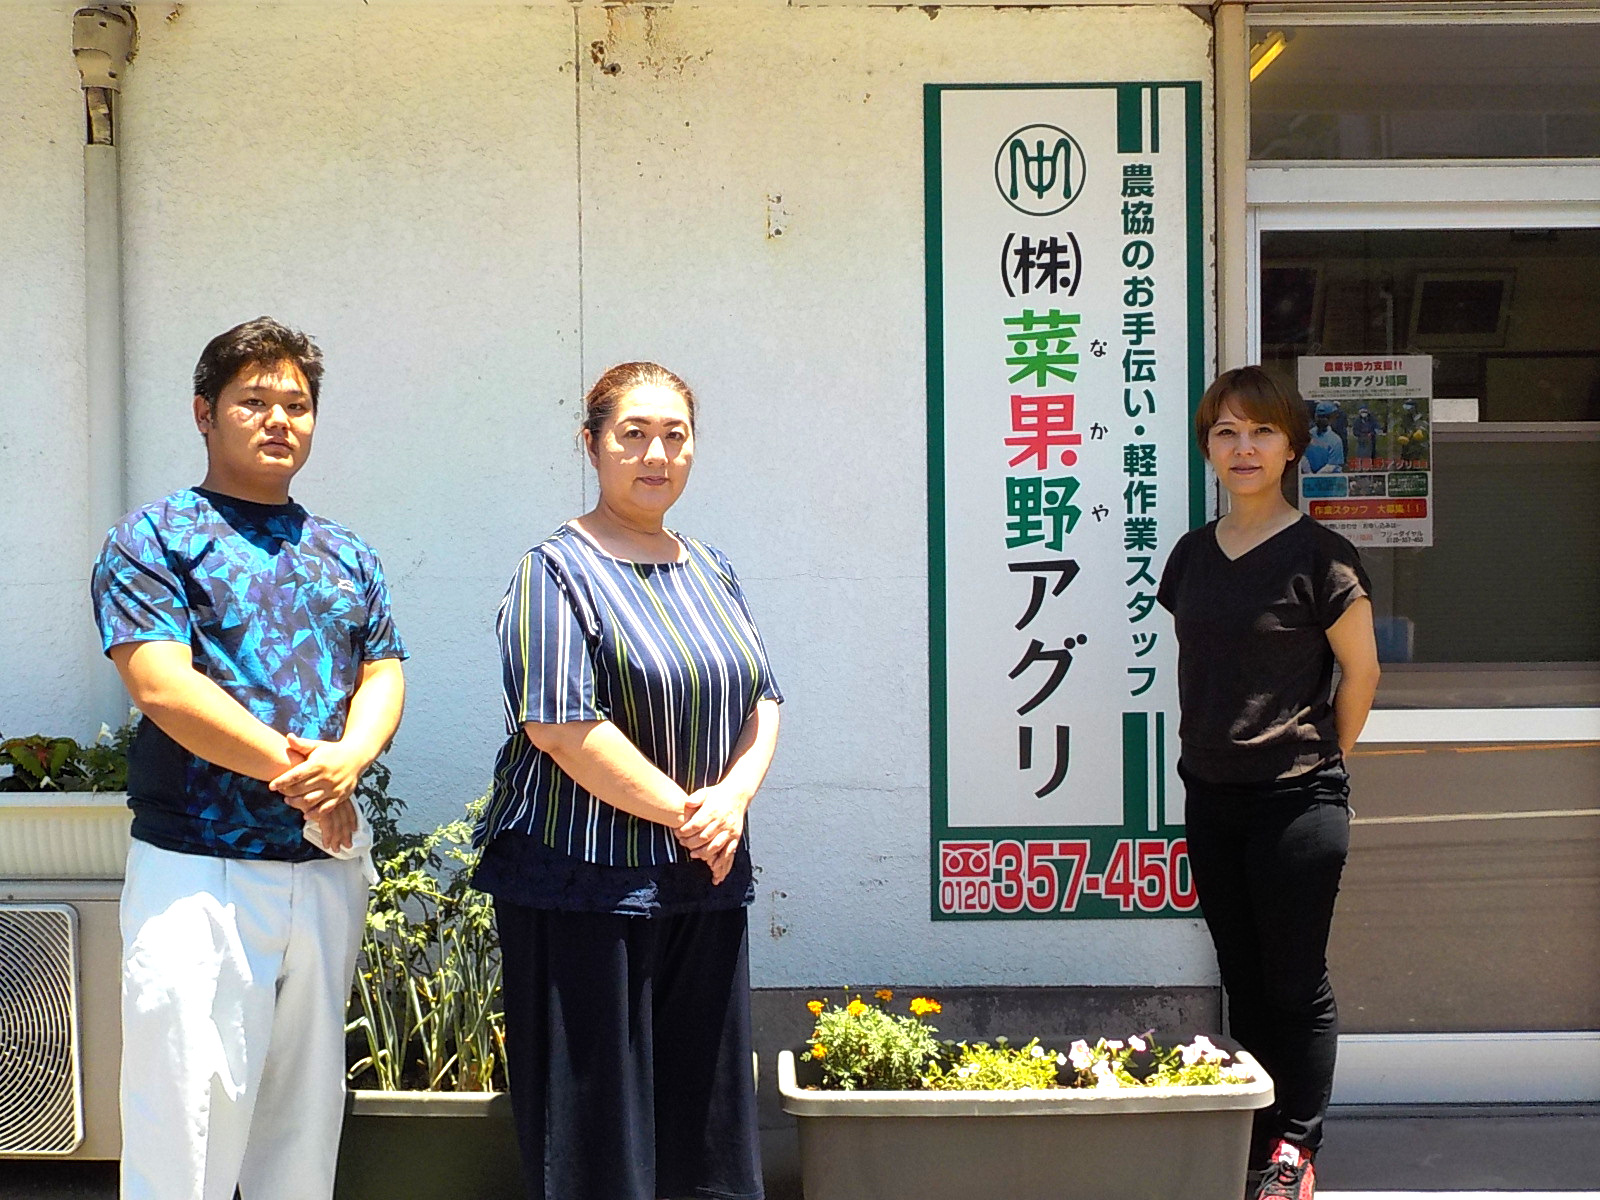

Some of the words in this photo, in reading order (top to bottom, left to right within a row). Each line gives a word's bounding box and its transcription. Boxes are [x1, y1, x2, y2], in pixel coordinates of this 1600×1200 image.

[1120, 163, 1158, 697] 農協のお手伝い・軽作業スタッフ
[940, 880, 992, 914] 0120
[993, 839, 1199, 913] 357-450
